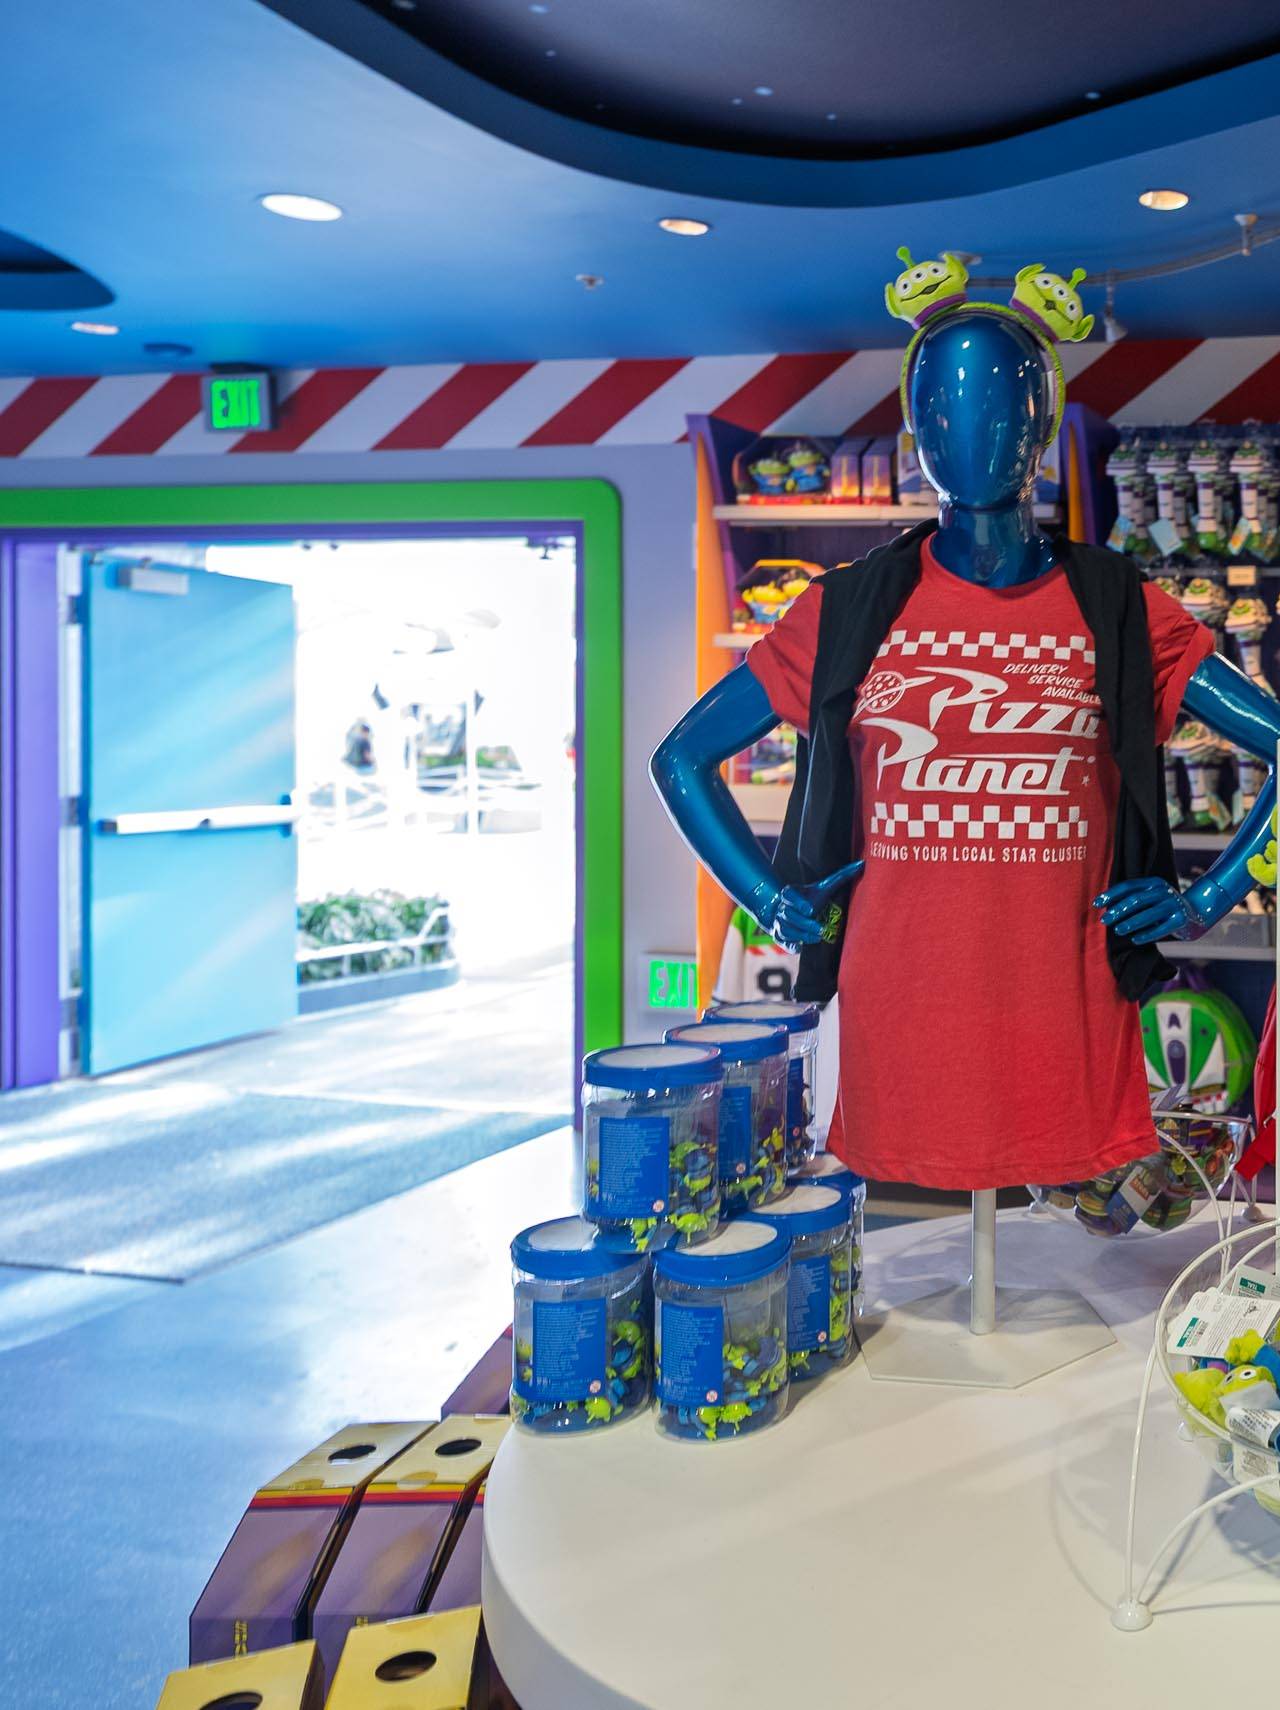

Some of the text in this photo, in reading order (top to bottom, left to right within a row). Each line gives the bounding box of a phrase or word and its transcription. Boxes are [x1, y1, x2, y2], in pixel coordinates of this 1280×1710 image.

[211, 380, 260, 429] EXIT
[1002, 663, 1069, 675] DELIVERY
[1027, 675, 1084, 688] SERVICE
[859, 717, 1086, 796] Planet
[913, 845, 947, 862] YOUR
[953, 846, 996, 863] LOCAL
[1002, 847, 1037, 863] STAR
